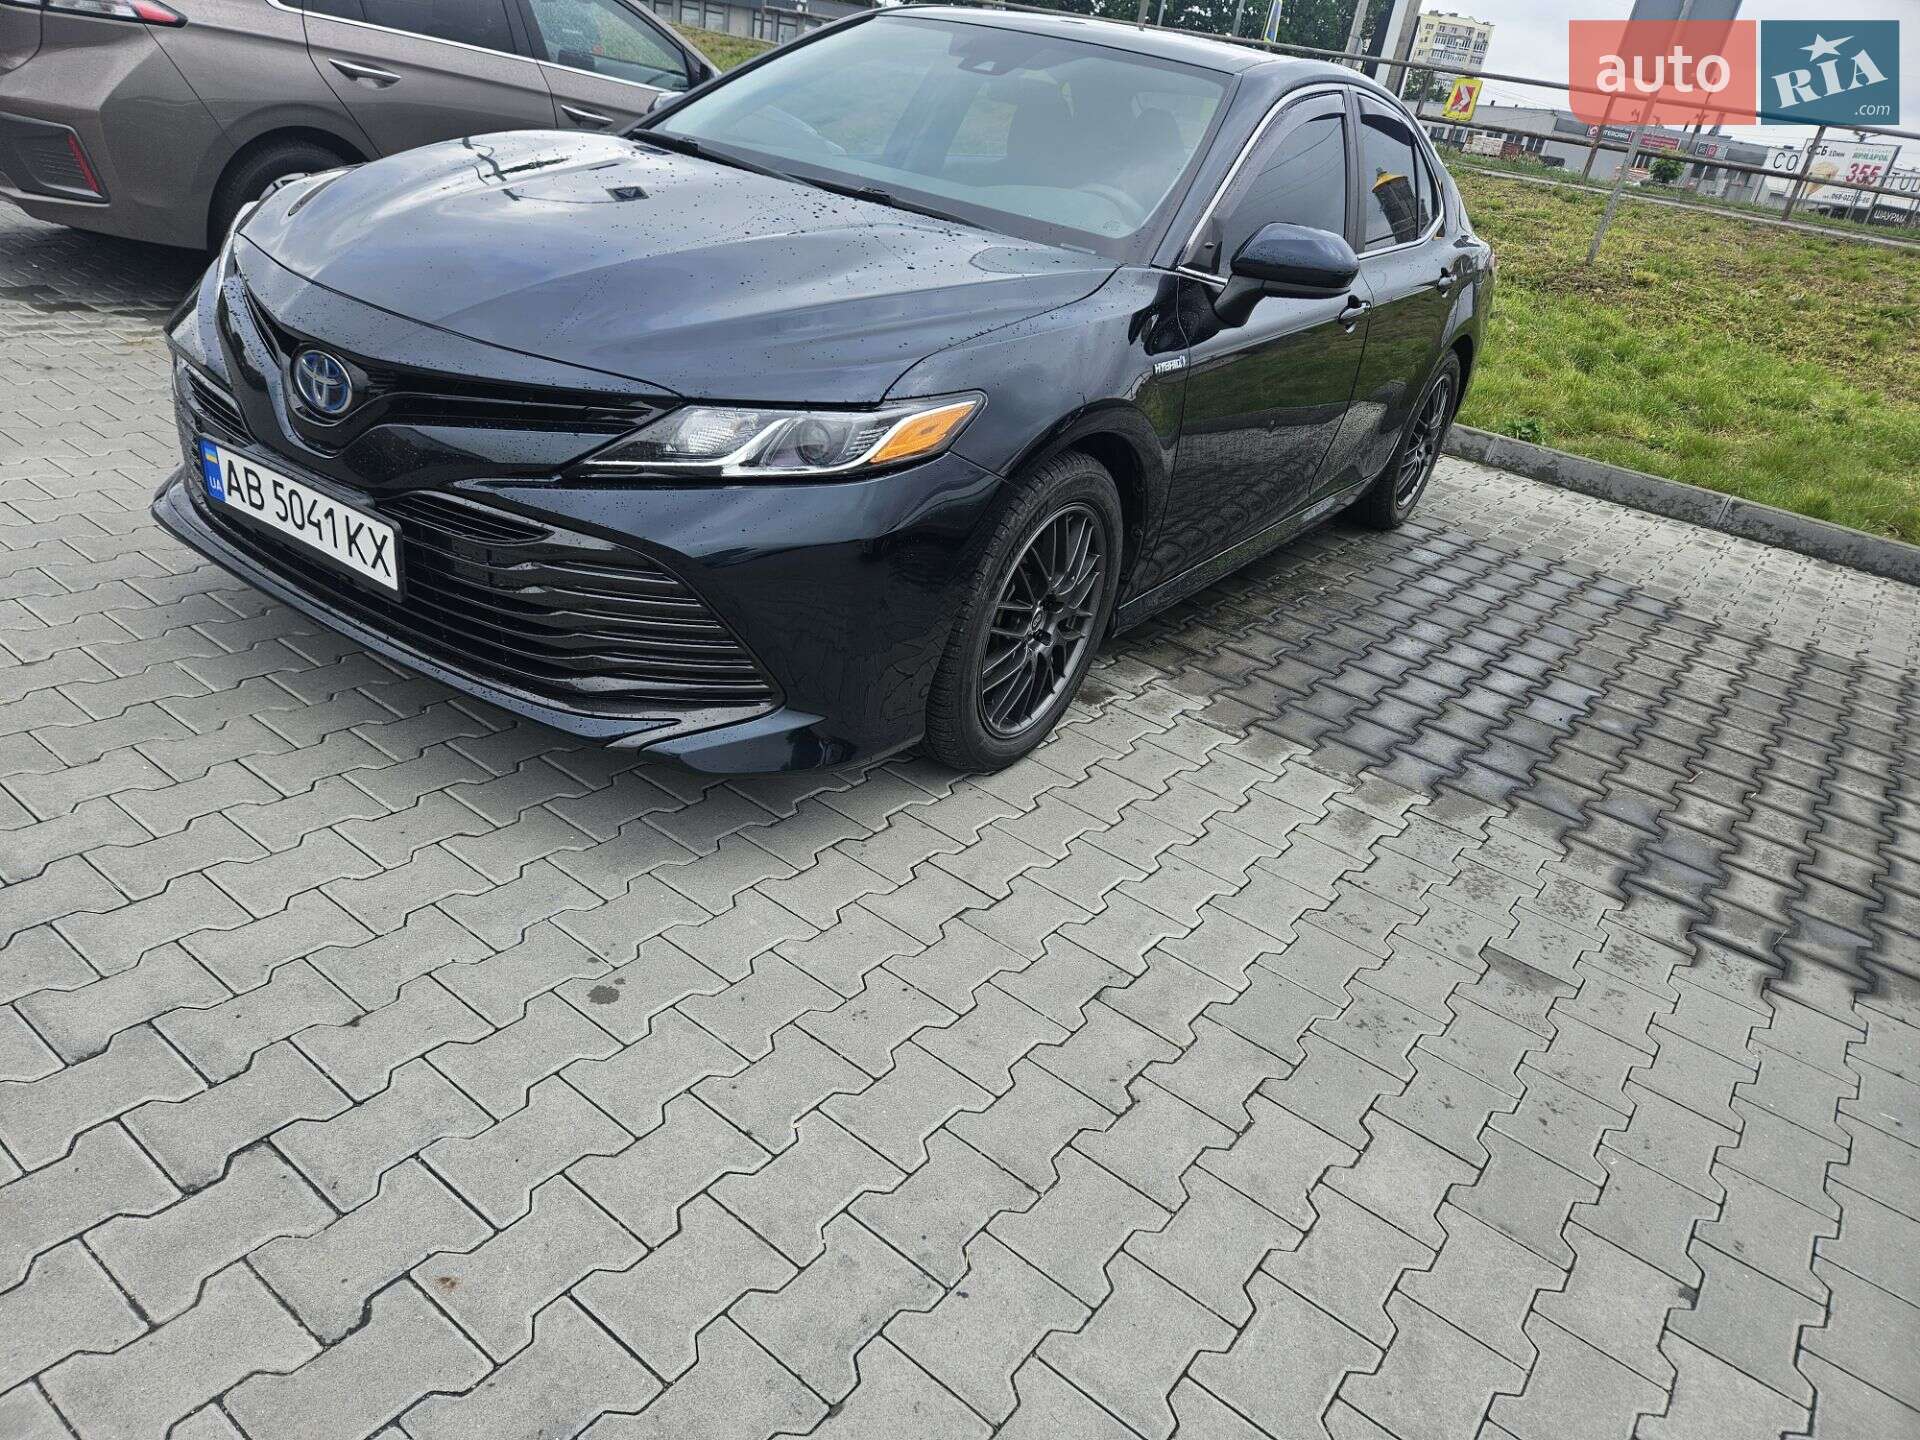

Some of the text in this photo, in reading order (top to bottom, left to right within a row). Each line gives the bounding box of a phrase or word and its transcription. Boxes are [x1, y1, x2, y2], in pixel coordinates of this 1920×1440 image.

[1845, 163, 1882, 185] 355
[1154, 359, 1182, 374] HYBRID
[209, 475, 223, 493] UA
[227, 459, 391, 577] AB 5041 KX
